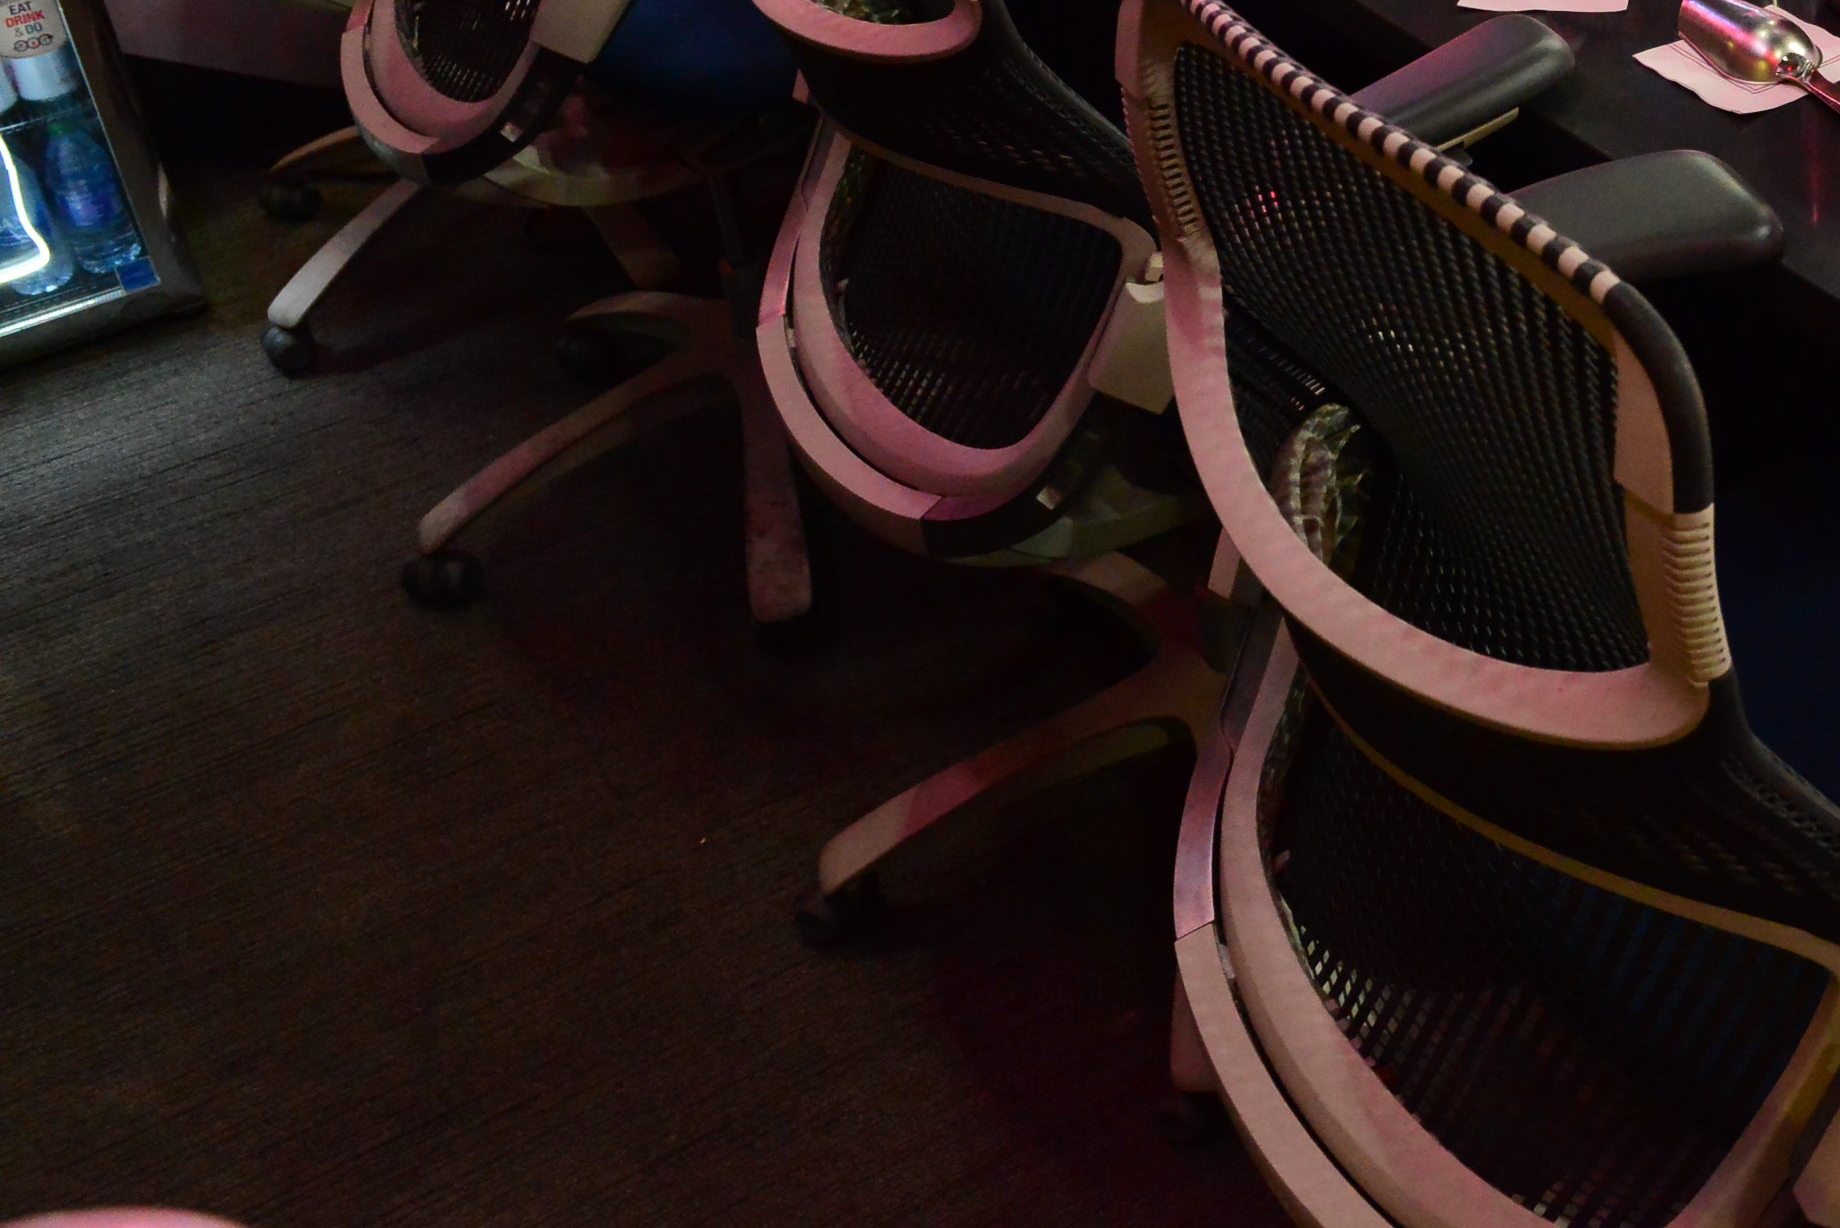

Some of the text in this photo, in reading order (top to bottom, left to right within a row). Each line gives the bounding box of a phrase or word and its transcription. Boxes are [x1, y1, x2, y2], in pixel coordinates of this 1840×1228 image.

[9, 1, 32, 15] EAT
[5, 10, 45, 28] DRINK
[25, 21, 43, 34] DO
